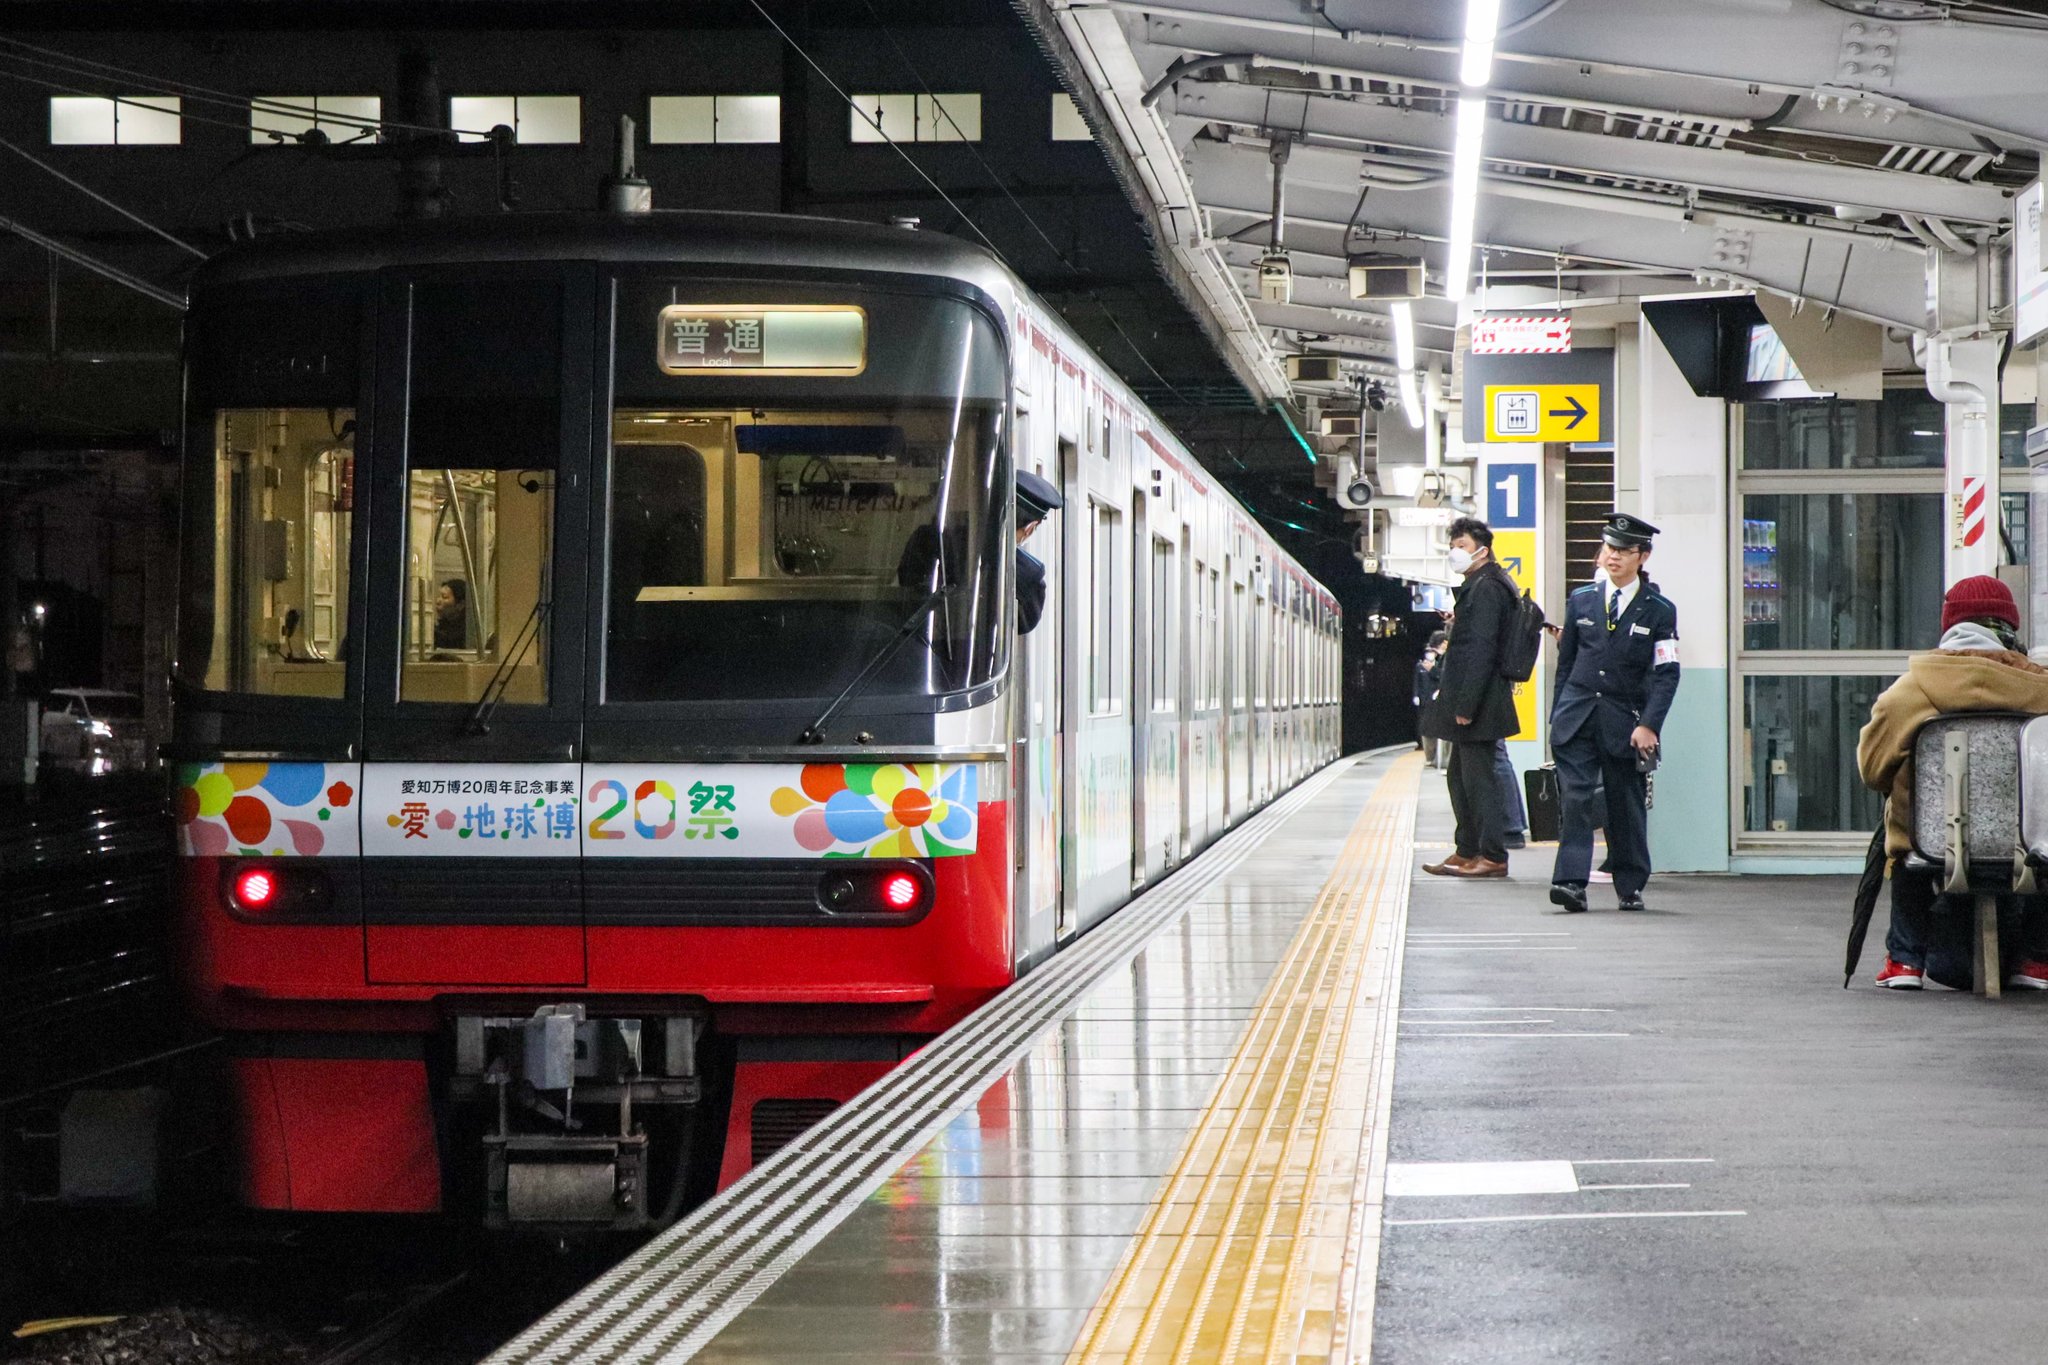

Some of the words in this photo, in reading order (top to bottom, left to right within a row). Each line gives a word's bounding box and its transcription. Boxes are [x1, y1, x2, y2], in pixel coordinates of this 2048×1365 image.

[673, 318, 760, 354] 普通
[702, 357, 732, 366] Local
[1495, 474, 1519, 518] 1
[401, 780, 575, 794] 愛知万博20周年記念事業
